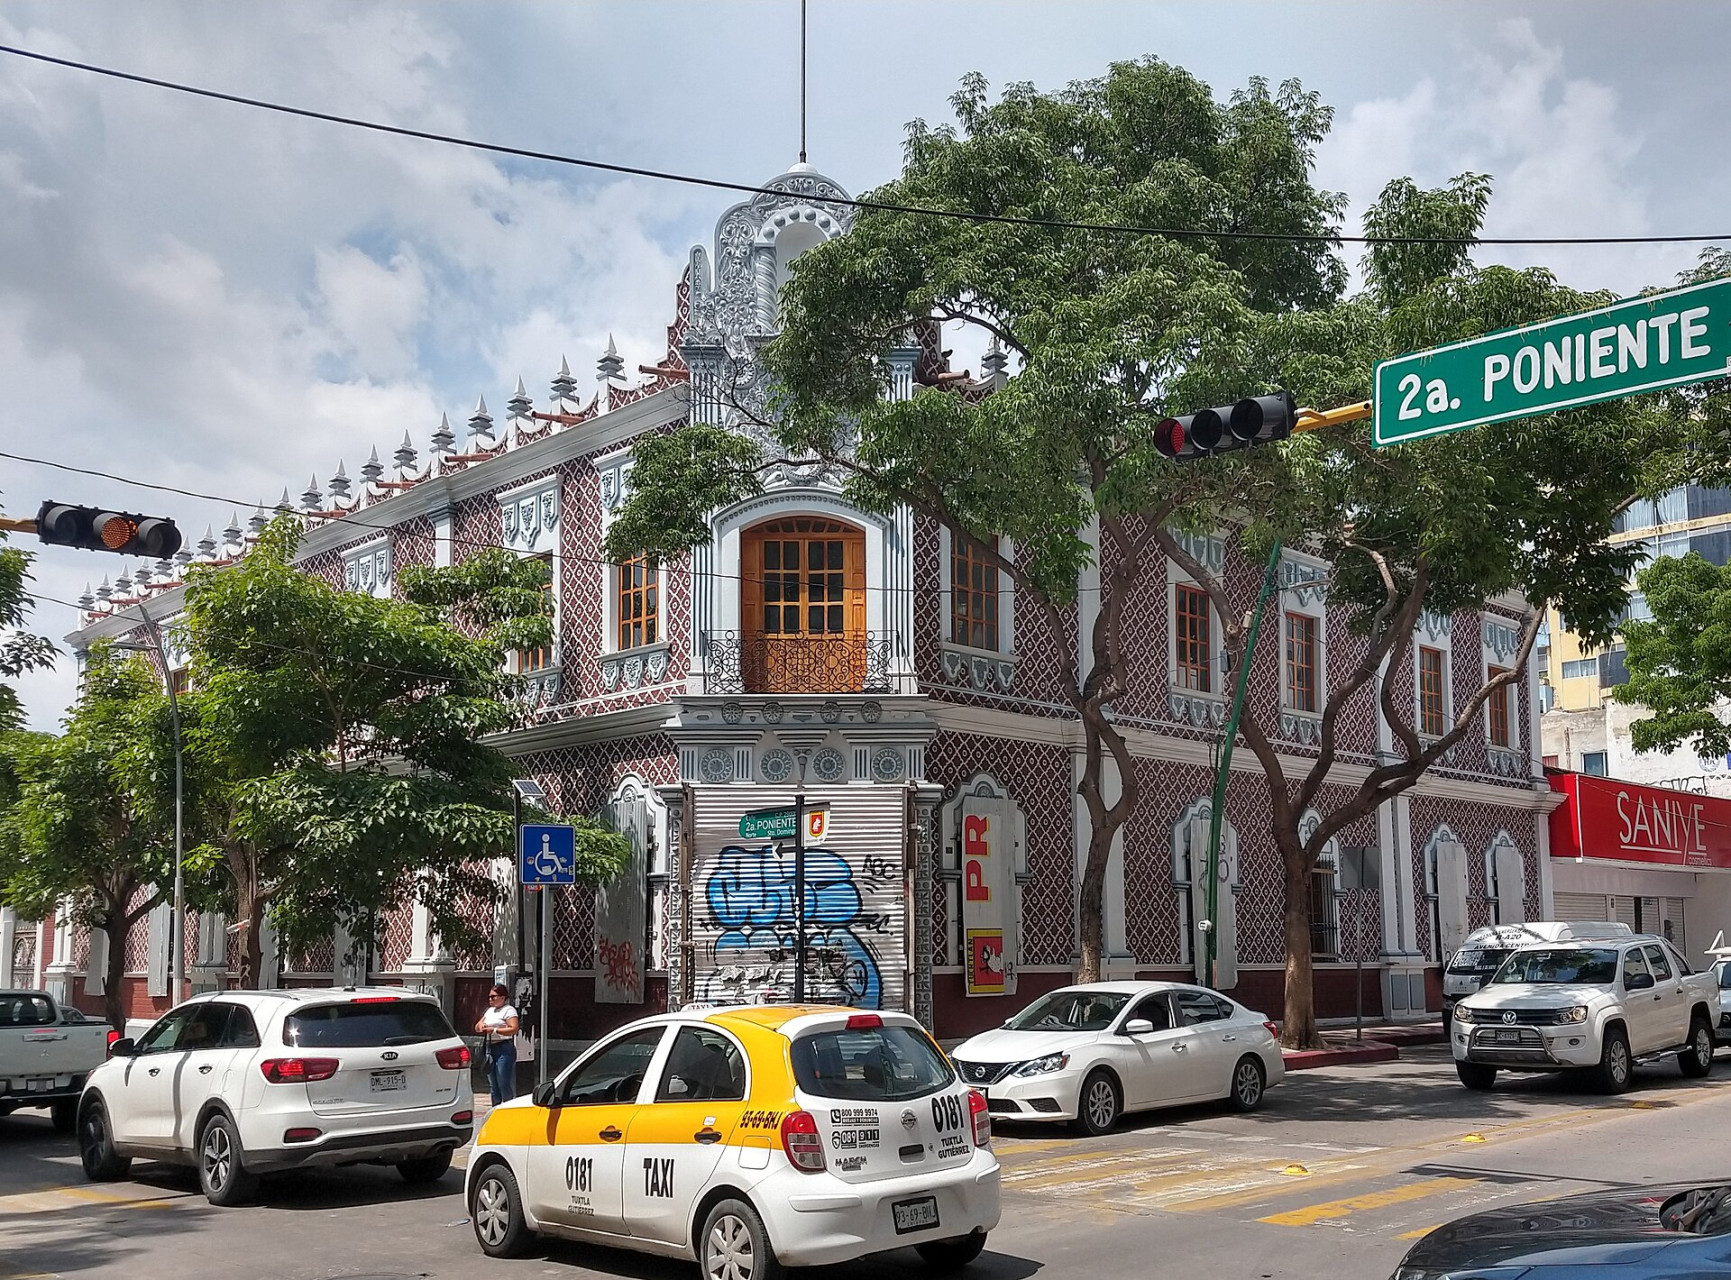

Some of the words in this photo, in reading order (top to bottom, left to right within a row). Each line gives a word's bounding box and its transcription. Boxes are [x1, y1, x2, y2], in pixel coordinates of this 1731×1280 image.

[1398, 373, 1461, 421] 2a.
[1484, 306, 1711, 402] PONIENTE
[745, 822, 756, 832] 2a.
[757, 817, 797, 830] PONIENTE
[1617, 791, 1706, 866] SANIYE
[776, 828, 797, 836] Doming
[1688, 856, 1713, 866] cosmetics
[383, 1052, 397, 1060] KIA
[740, 1110, 783, 1130] 93-69-BHJ
[931, 1094, 964, 1133] 0181
[842, 1131, 856, 1143] 089
[859, 1130, 879, 1141] 911
[941, 1135, 964, 1147] TUXTLA
[566, 1156, 593, 1192] 0181
[643, 1158, 675, 1198] TAXI
[571, 1195, 590, 1206] TUXTLA
